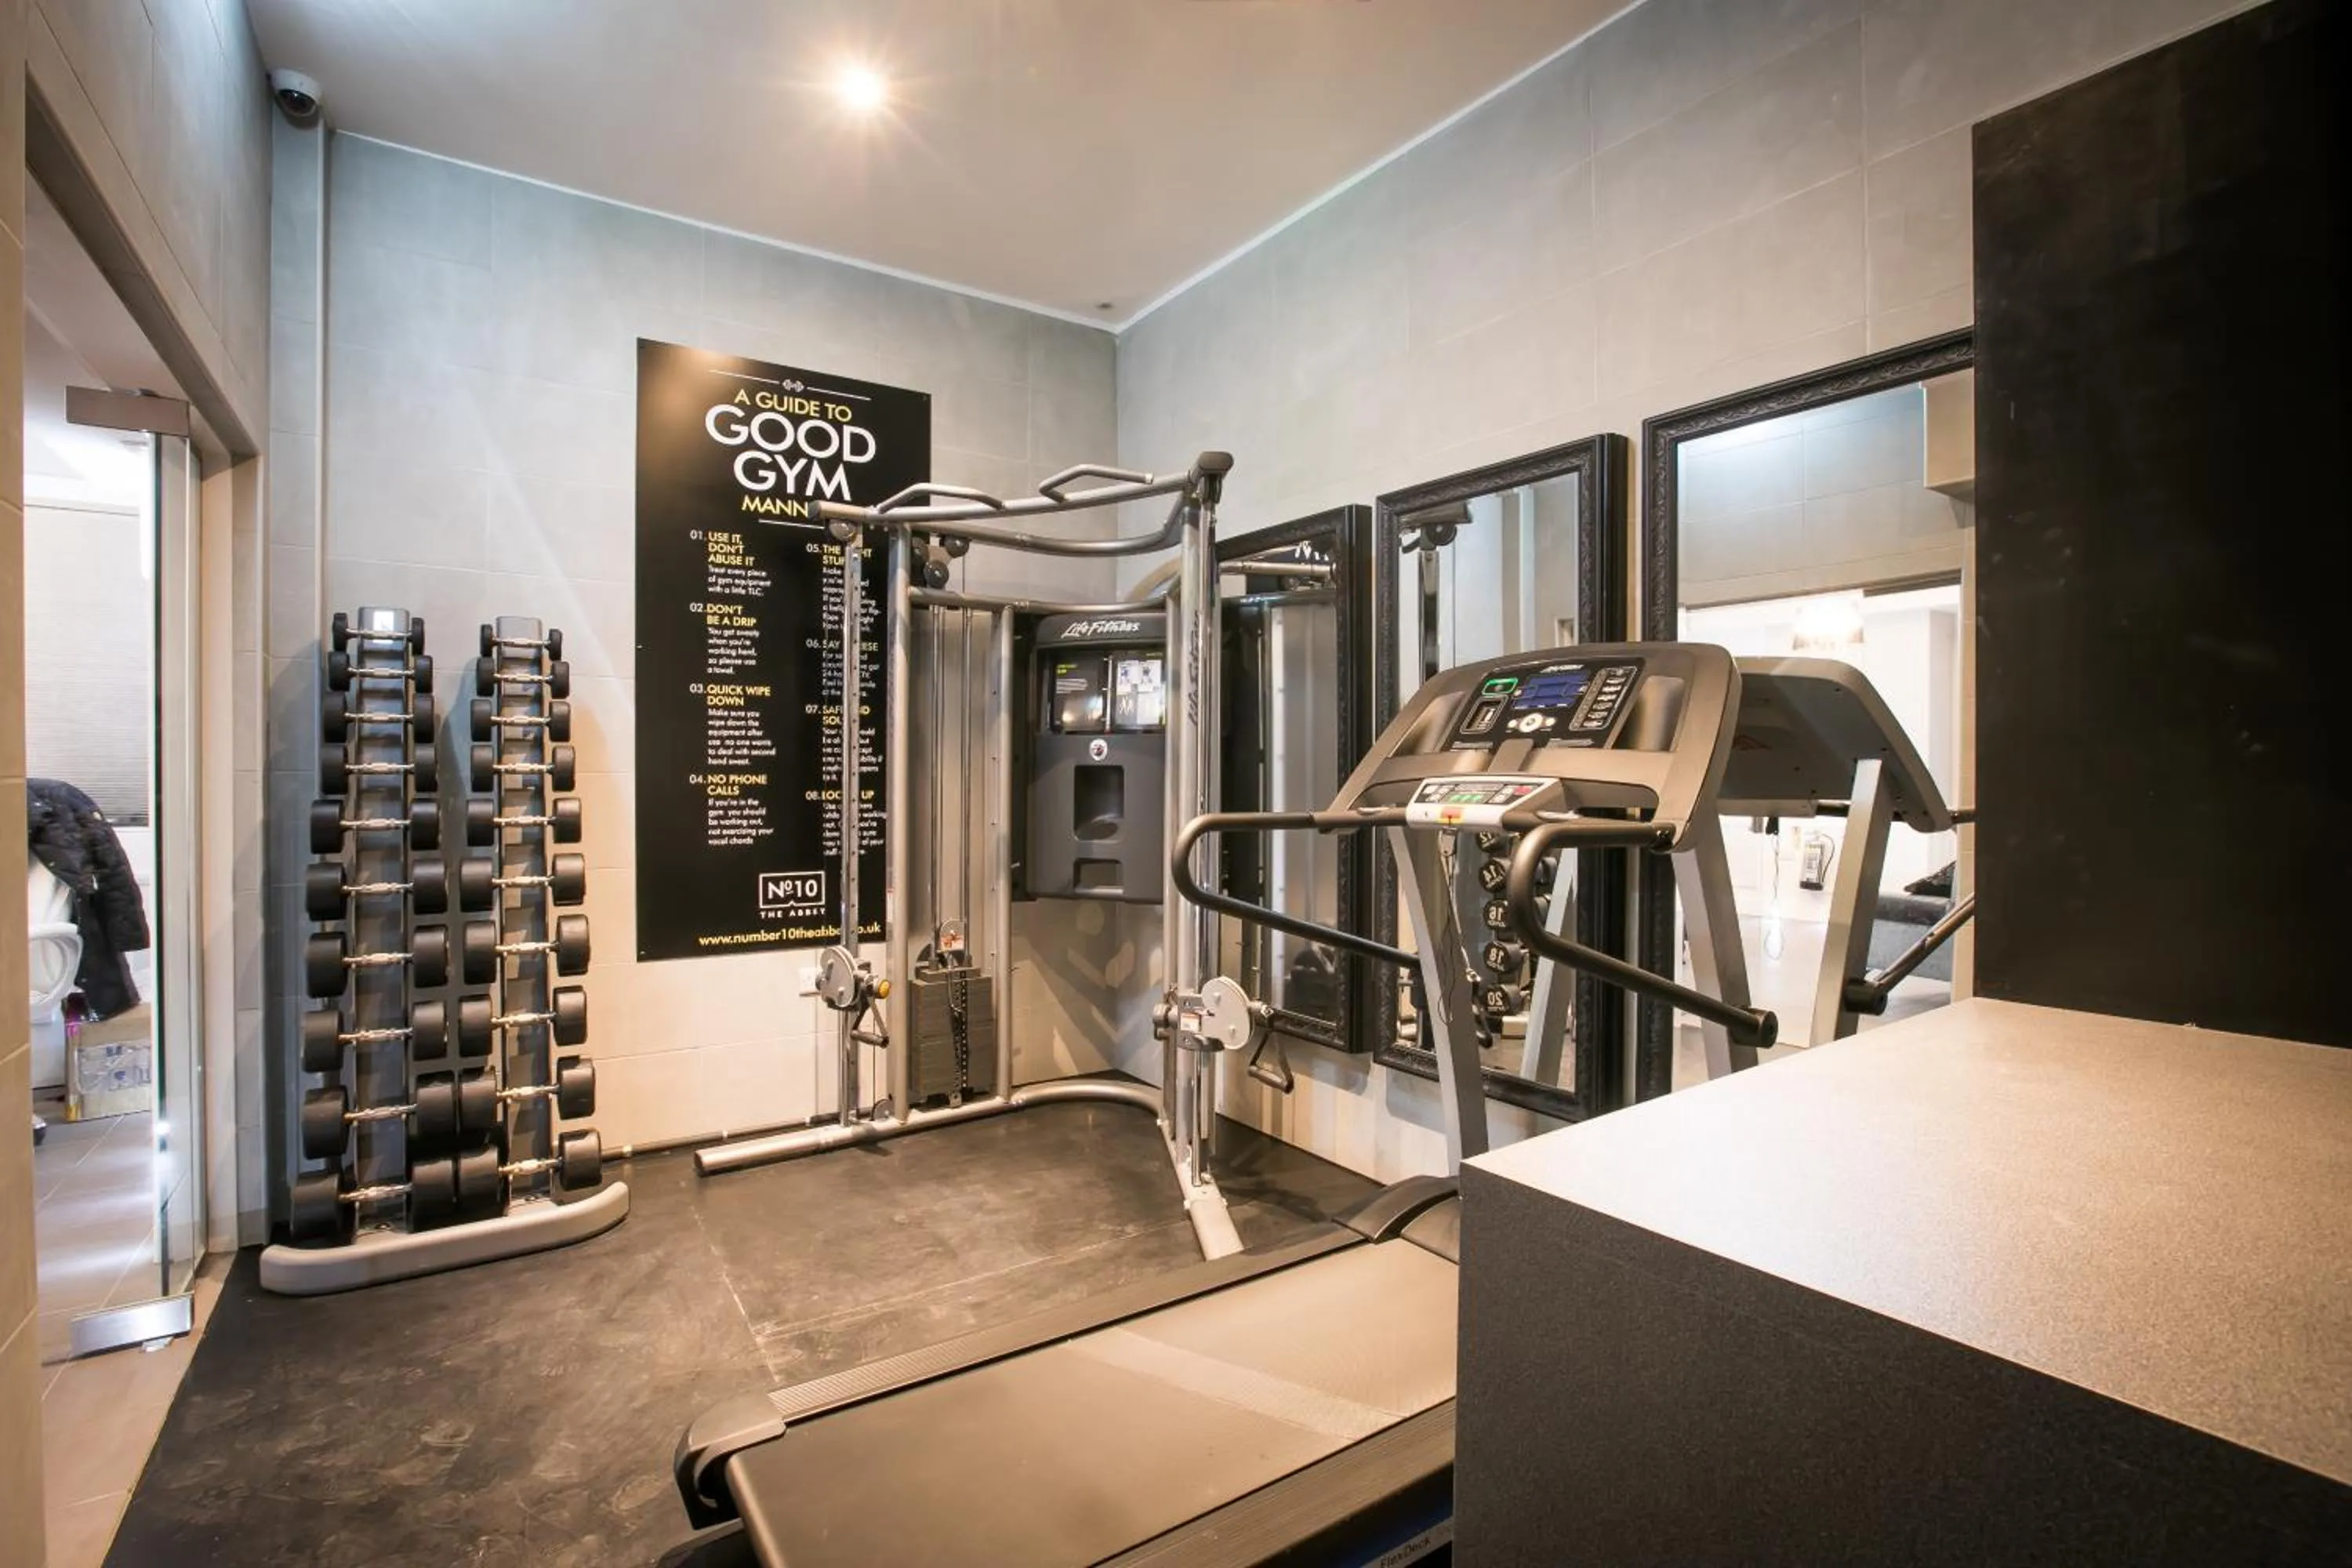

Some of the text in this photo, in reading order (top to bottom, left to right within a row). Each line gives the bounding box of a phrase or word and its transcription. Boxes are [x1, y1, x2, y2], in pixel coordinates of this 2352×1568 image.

[735, 389, 852, 423] A GUIDE TO
[705, 404, 877, 463] GOOD
[733, 450, 851, 501] GYM
[742, 495, 808, 518] MANN
[708, 532, 729, 542] USE
[708, 543, 744, 554] DON'T
[822, 544, 840, 554] THE
[708, 554, 755, 566] ABUSE IT
[707, 603, 743, 615] DON'T
[707, 615, 757, 626] BE A DRIP
[707, 684, 743, 695] QUICK
[746, 685, 771, 696] WIPE
[707, 695, 744, 706] DOWN
[822, 706, 843, 714] SAF
[708, 775, 726, 784] NO
[729, 774, 768, 784] PHONE
[707, 785, 740, 796] CALLS
[822, 790, 841, 800] LOC
[861, 790, 874, 800] UP
[760, 907, 826, 920] THE ABBEY
